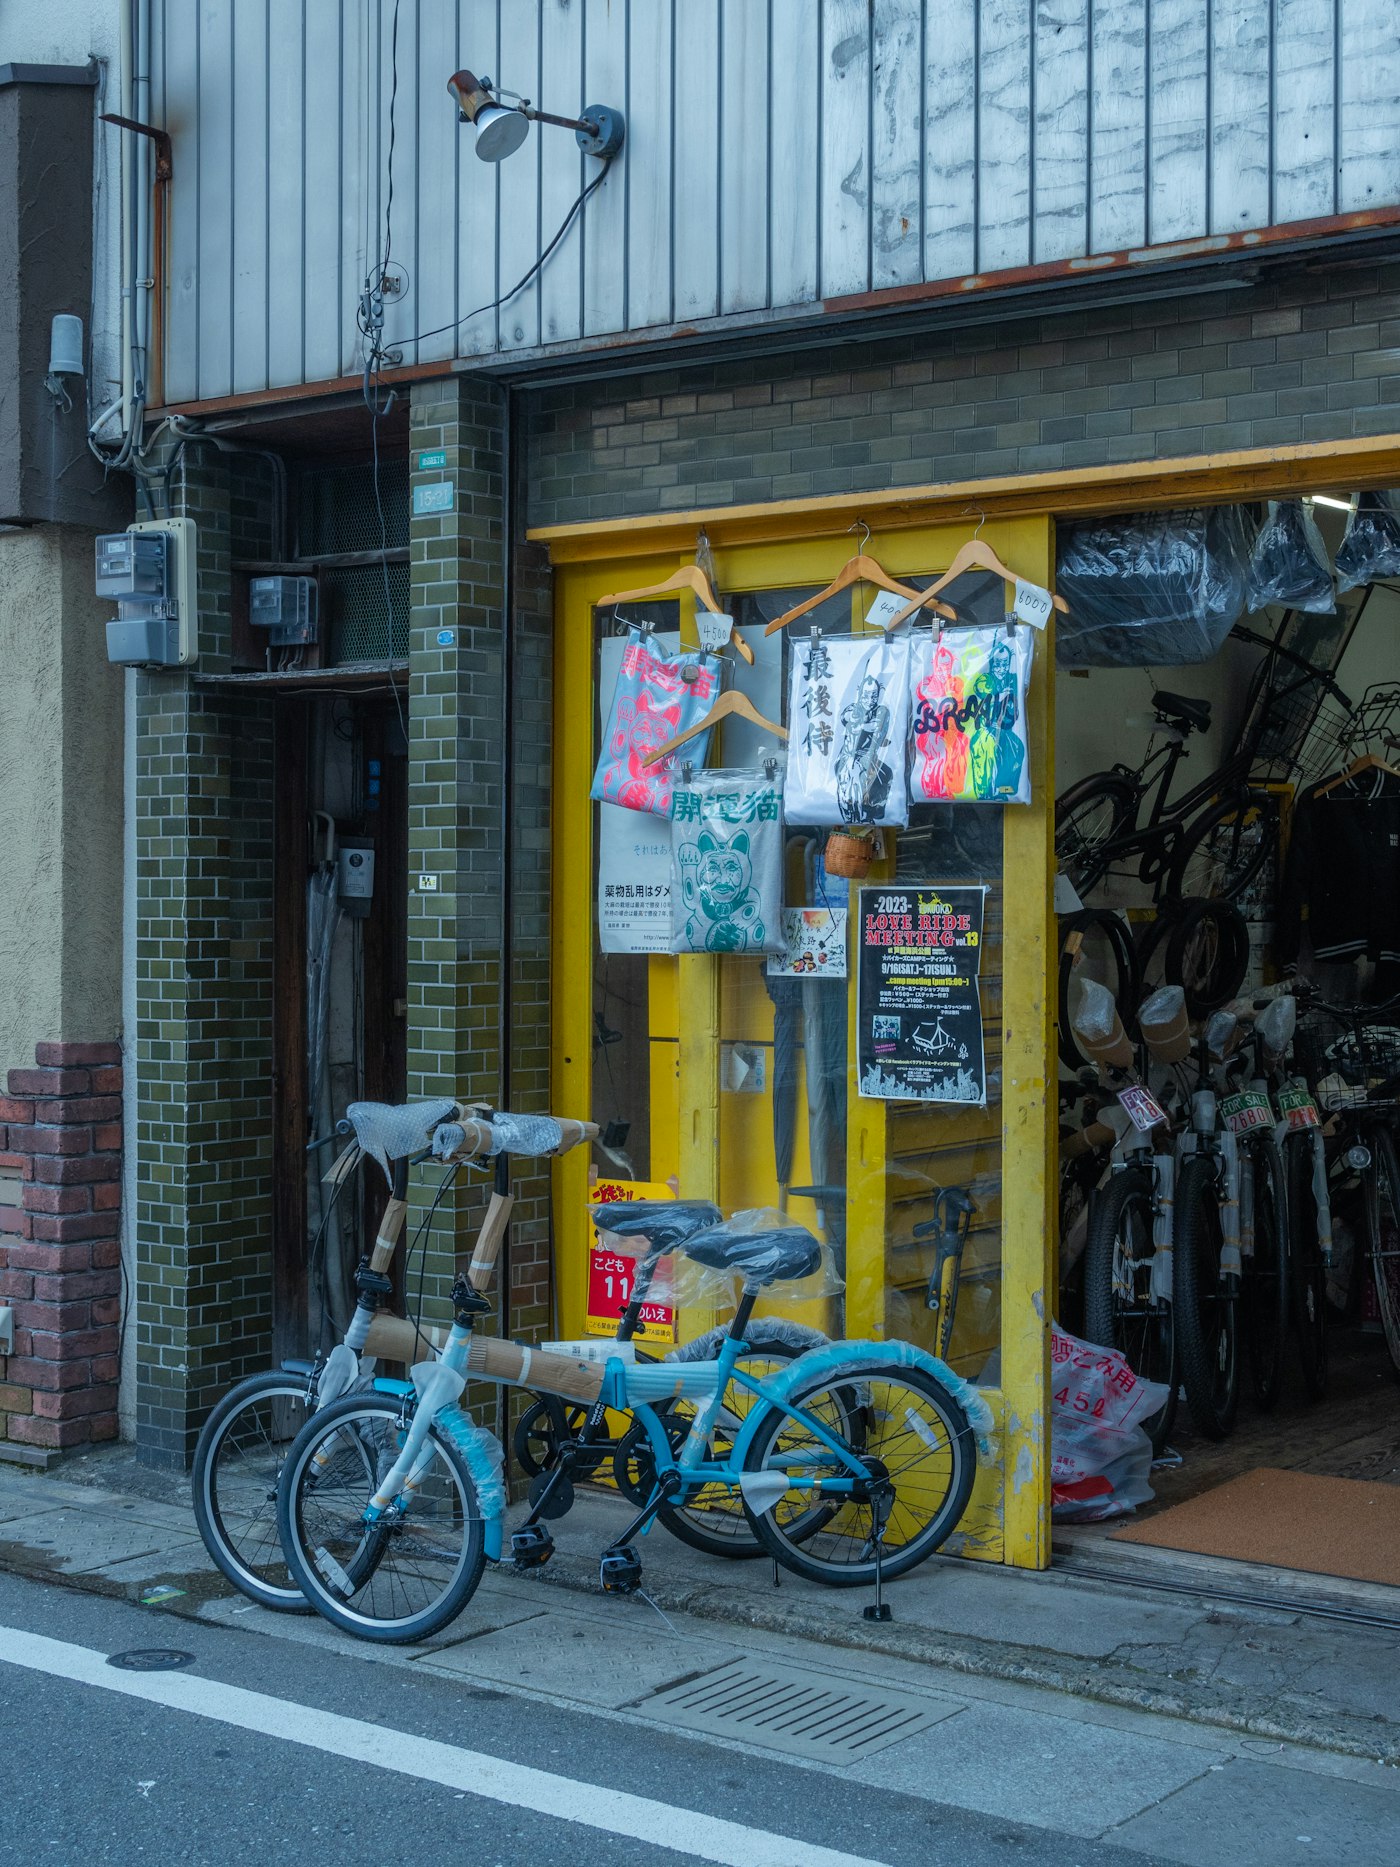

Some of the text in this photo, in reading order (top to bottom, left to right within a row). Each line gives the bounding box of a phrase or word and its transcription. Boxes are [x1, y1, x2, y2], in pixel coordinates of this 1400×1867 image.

[1018, 590, 1048, 614] 6000
[703, 624, 727, 641] 4500
[800, 646, 834, 757] 最後侍
[604, 884, 671, 898] 薬物乱用はダメ
[873, 896, 912, 914] -2023-
[865, 914, 971, 931] LOVE RIDE
[865, 930, 956, 947] MEETING
[1222, 1099, 1244, 1116] FOR
[594, 1257, 625, 1273] こども
[604, 1275, 629, 1300] 11
